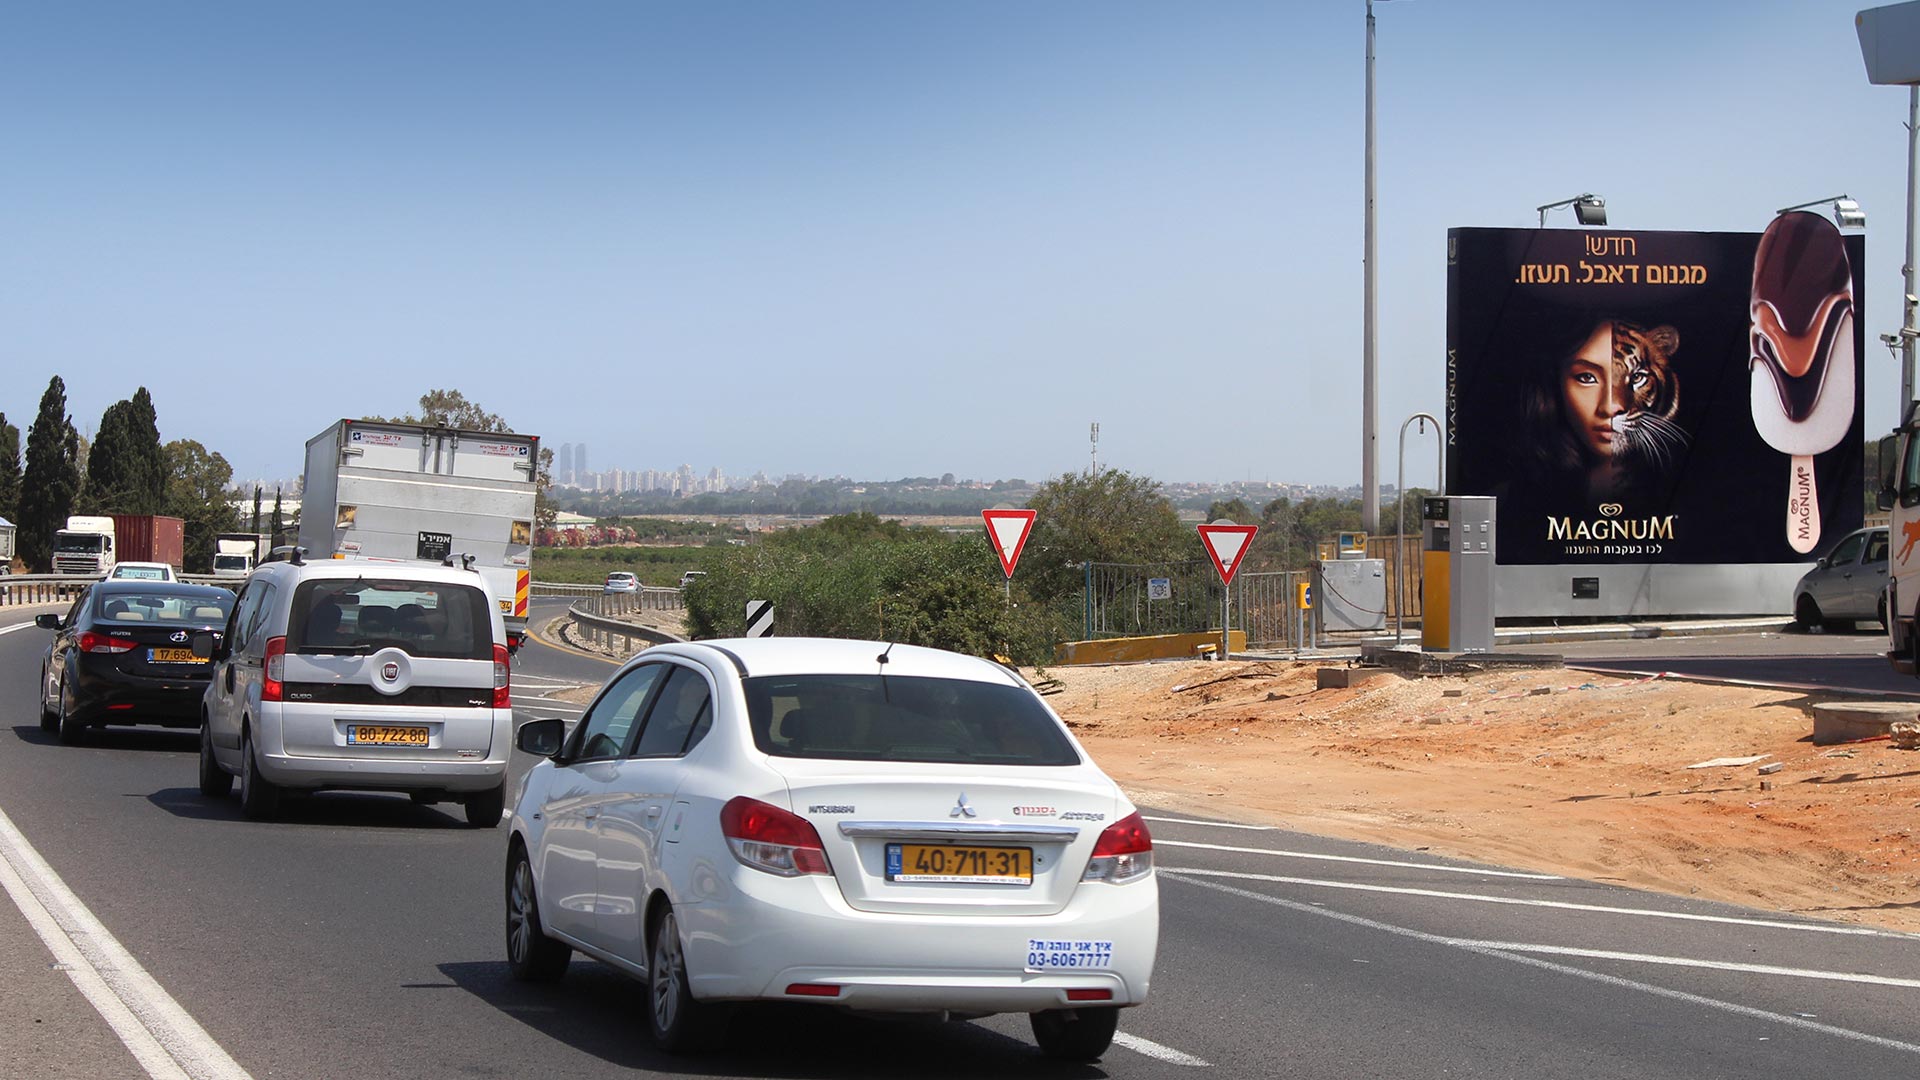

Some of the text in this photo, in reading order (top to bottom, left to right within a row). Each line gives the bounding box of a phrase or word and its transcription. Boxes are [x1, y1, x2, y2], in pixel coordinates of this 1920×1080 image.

[1585, 234, 1636, 256] חדש!
[1515, 260, 1707, 284] מגנום דאבל. תעזו.
[1448, 349, 1457, 446] MAGNUM
[1603, 545, 1643, 555] בעקבות
[1646, 544, 1662, 554] לכו
[809, 805, 855, 814] MITSUBISHI
[1029, 939, 1112, 953] איך אני נוהג/ת?
[1028, 952, 1111, 967] 03-6067777
